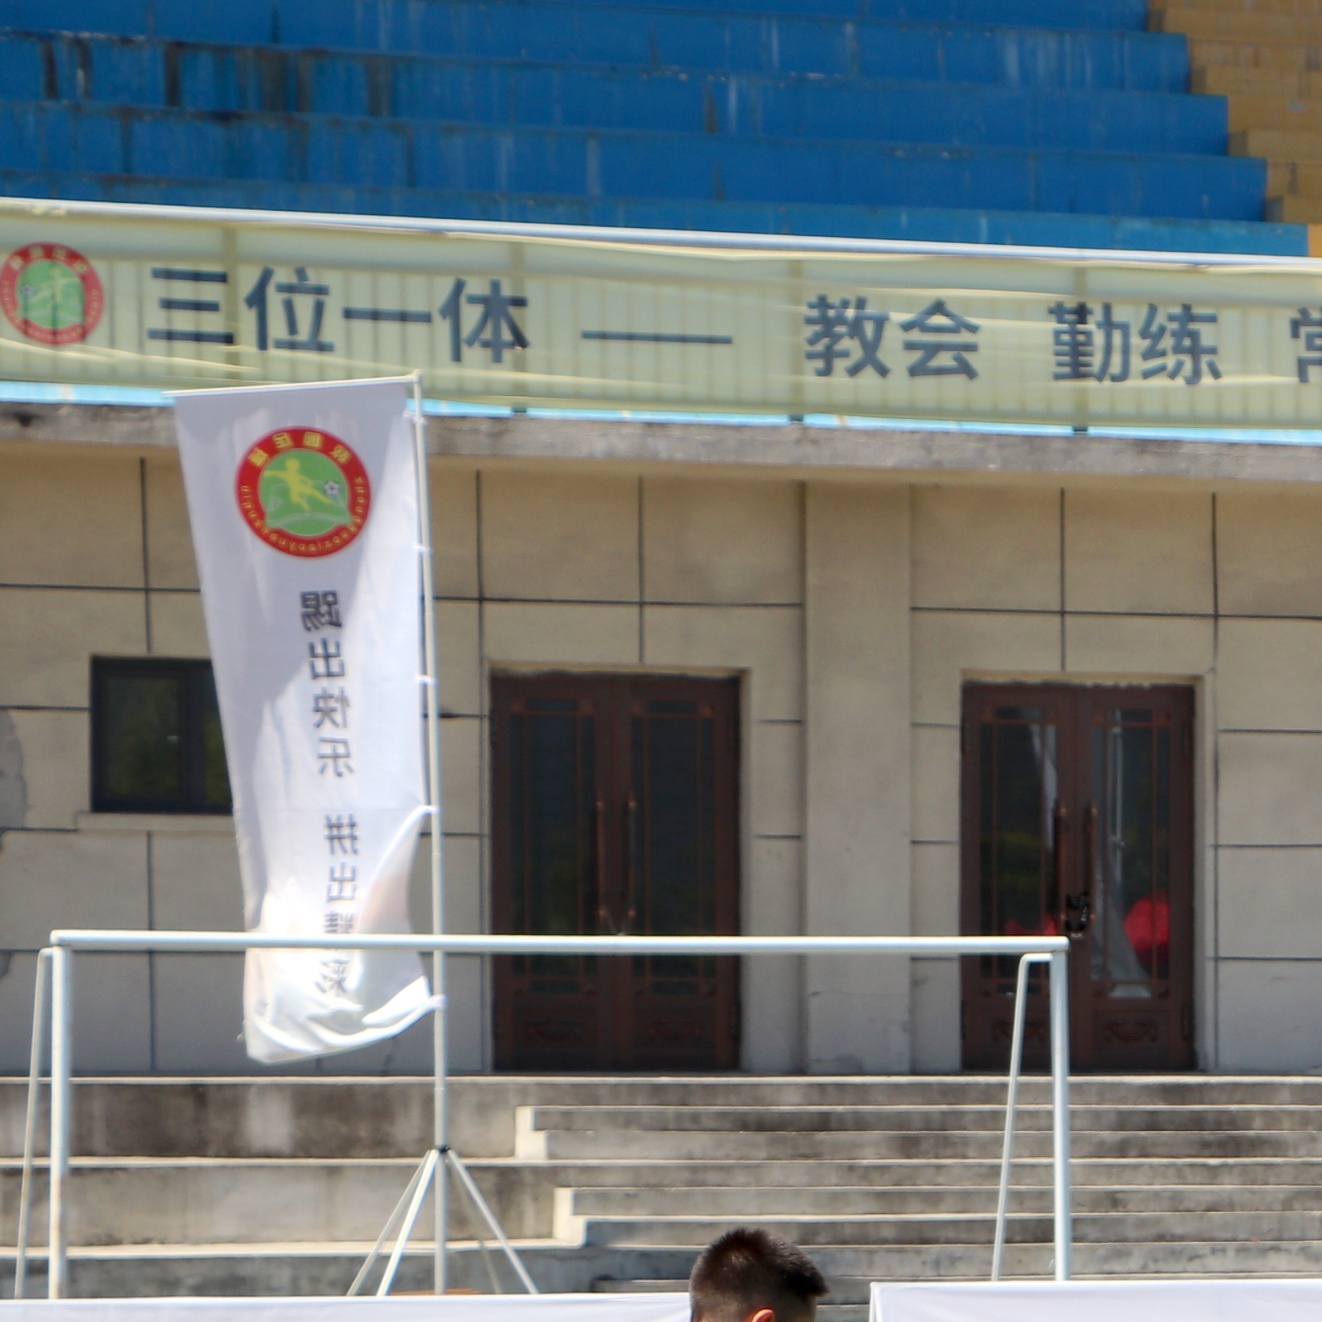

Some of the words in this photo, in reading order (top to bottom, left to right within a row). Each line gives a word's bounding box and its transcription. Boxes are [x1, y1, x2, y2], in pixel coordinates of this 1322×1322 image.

[147, 266, 529, 363] 三位一体
[803, 293, 982, 380] 教会
[1047, 301, 1222, 386] 勤练
